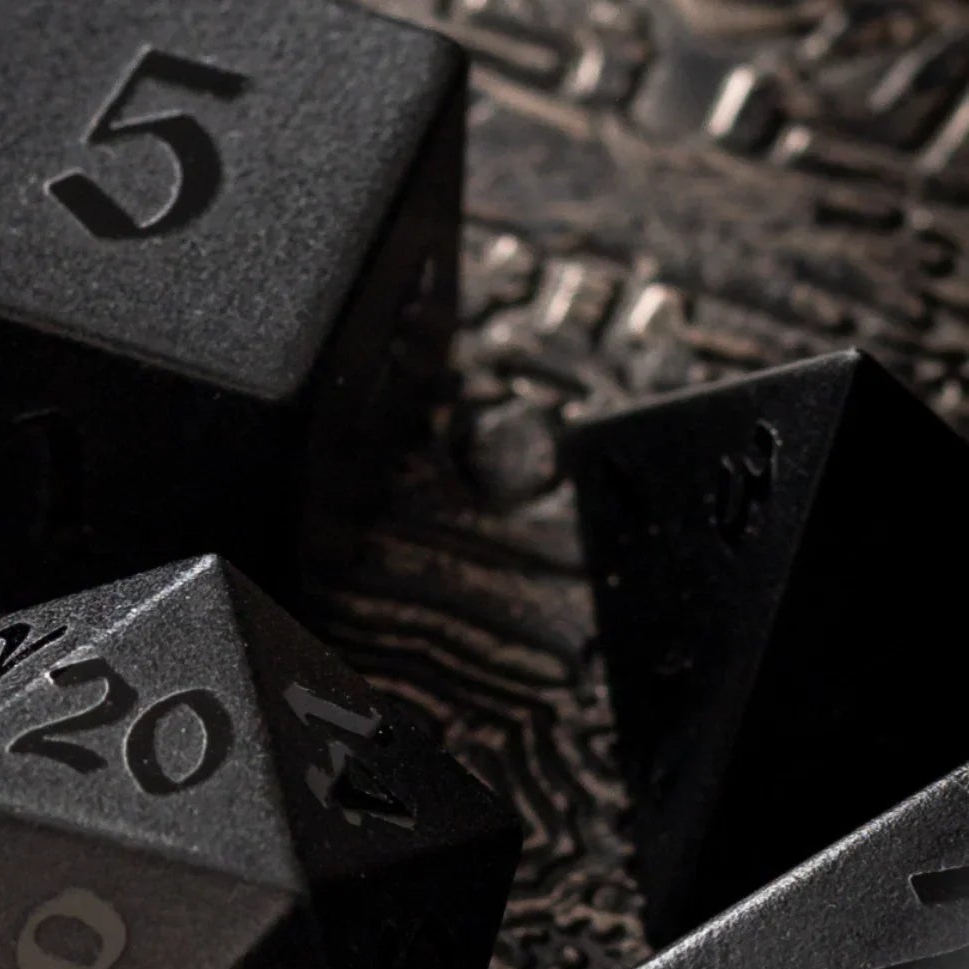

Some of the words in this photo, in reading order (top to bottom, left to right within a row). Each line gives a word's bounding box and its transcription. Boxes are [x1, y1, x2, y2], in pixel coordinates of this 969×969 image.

[43, 46, 252, 241] 5
[7, 655, 233, 797] 20
[283, 681, 418, 832] 14
